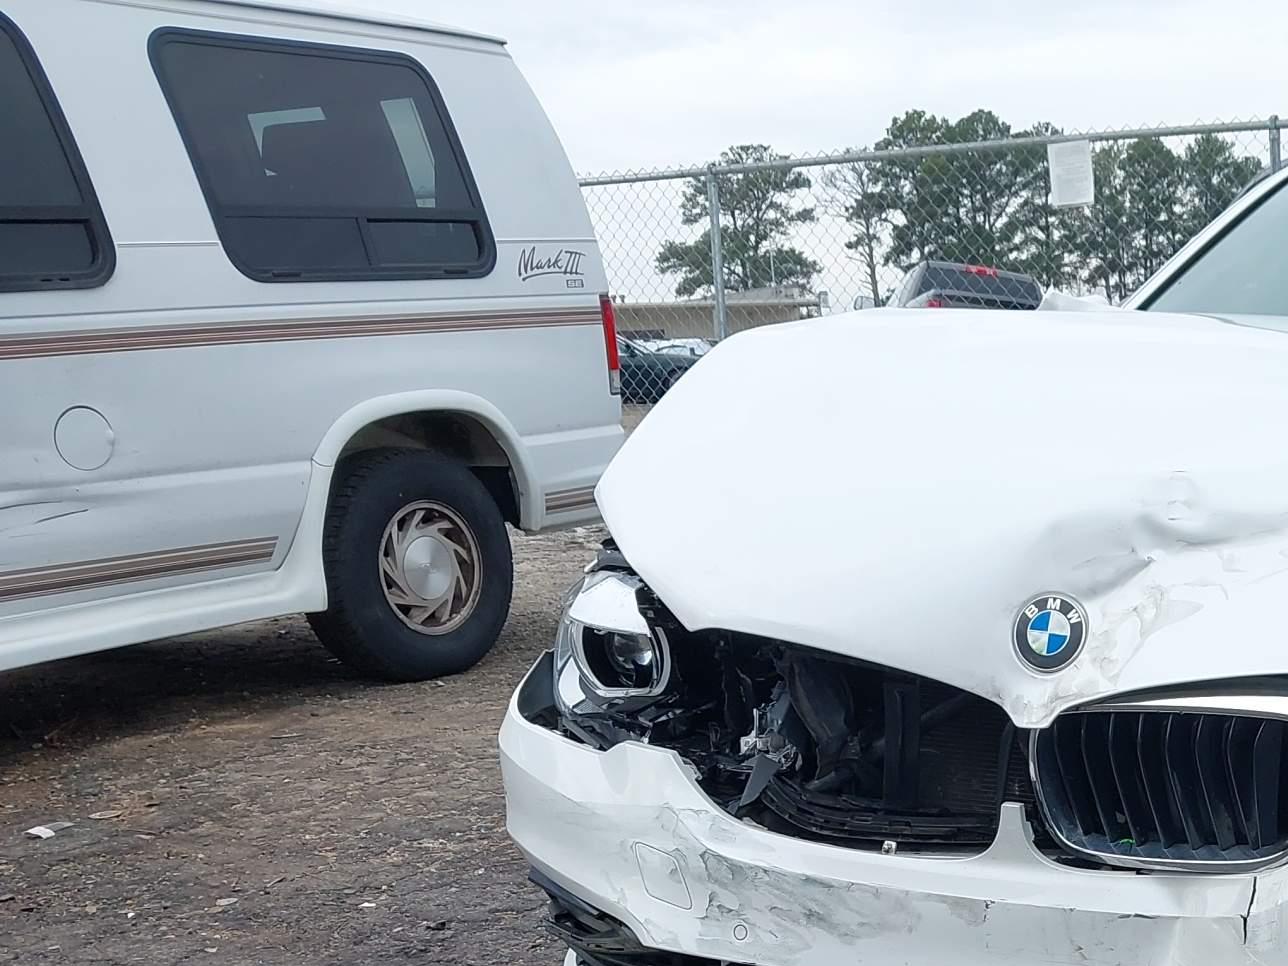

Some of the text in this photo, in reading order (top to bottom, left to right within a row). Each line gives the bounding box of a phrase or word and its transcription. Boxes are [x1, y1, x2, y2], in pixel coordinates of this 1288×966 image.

[518, 245, 586, 277] Mark III
[1024, 597, 1082, 625] BMW
